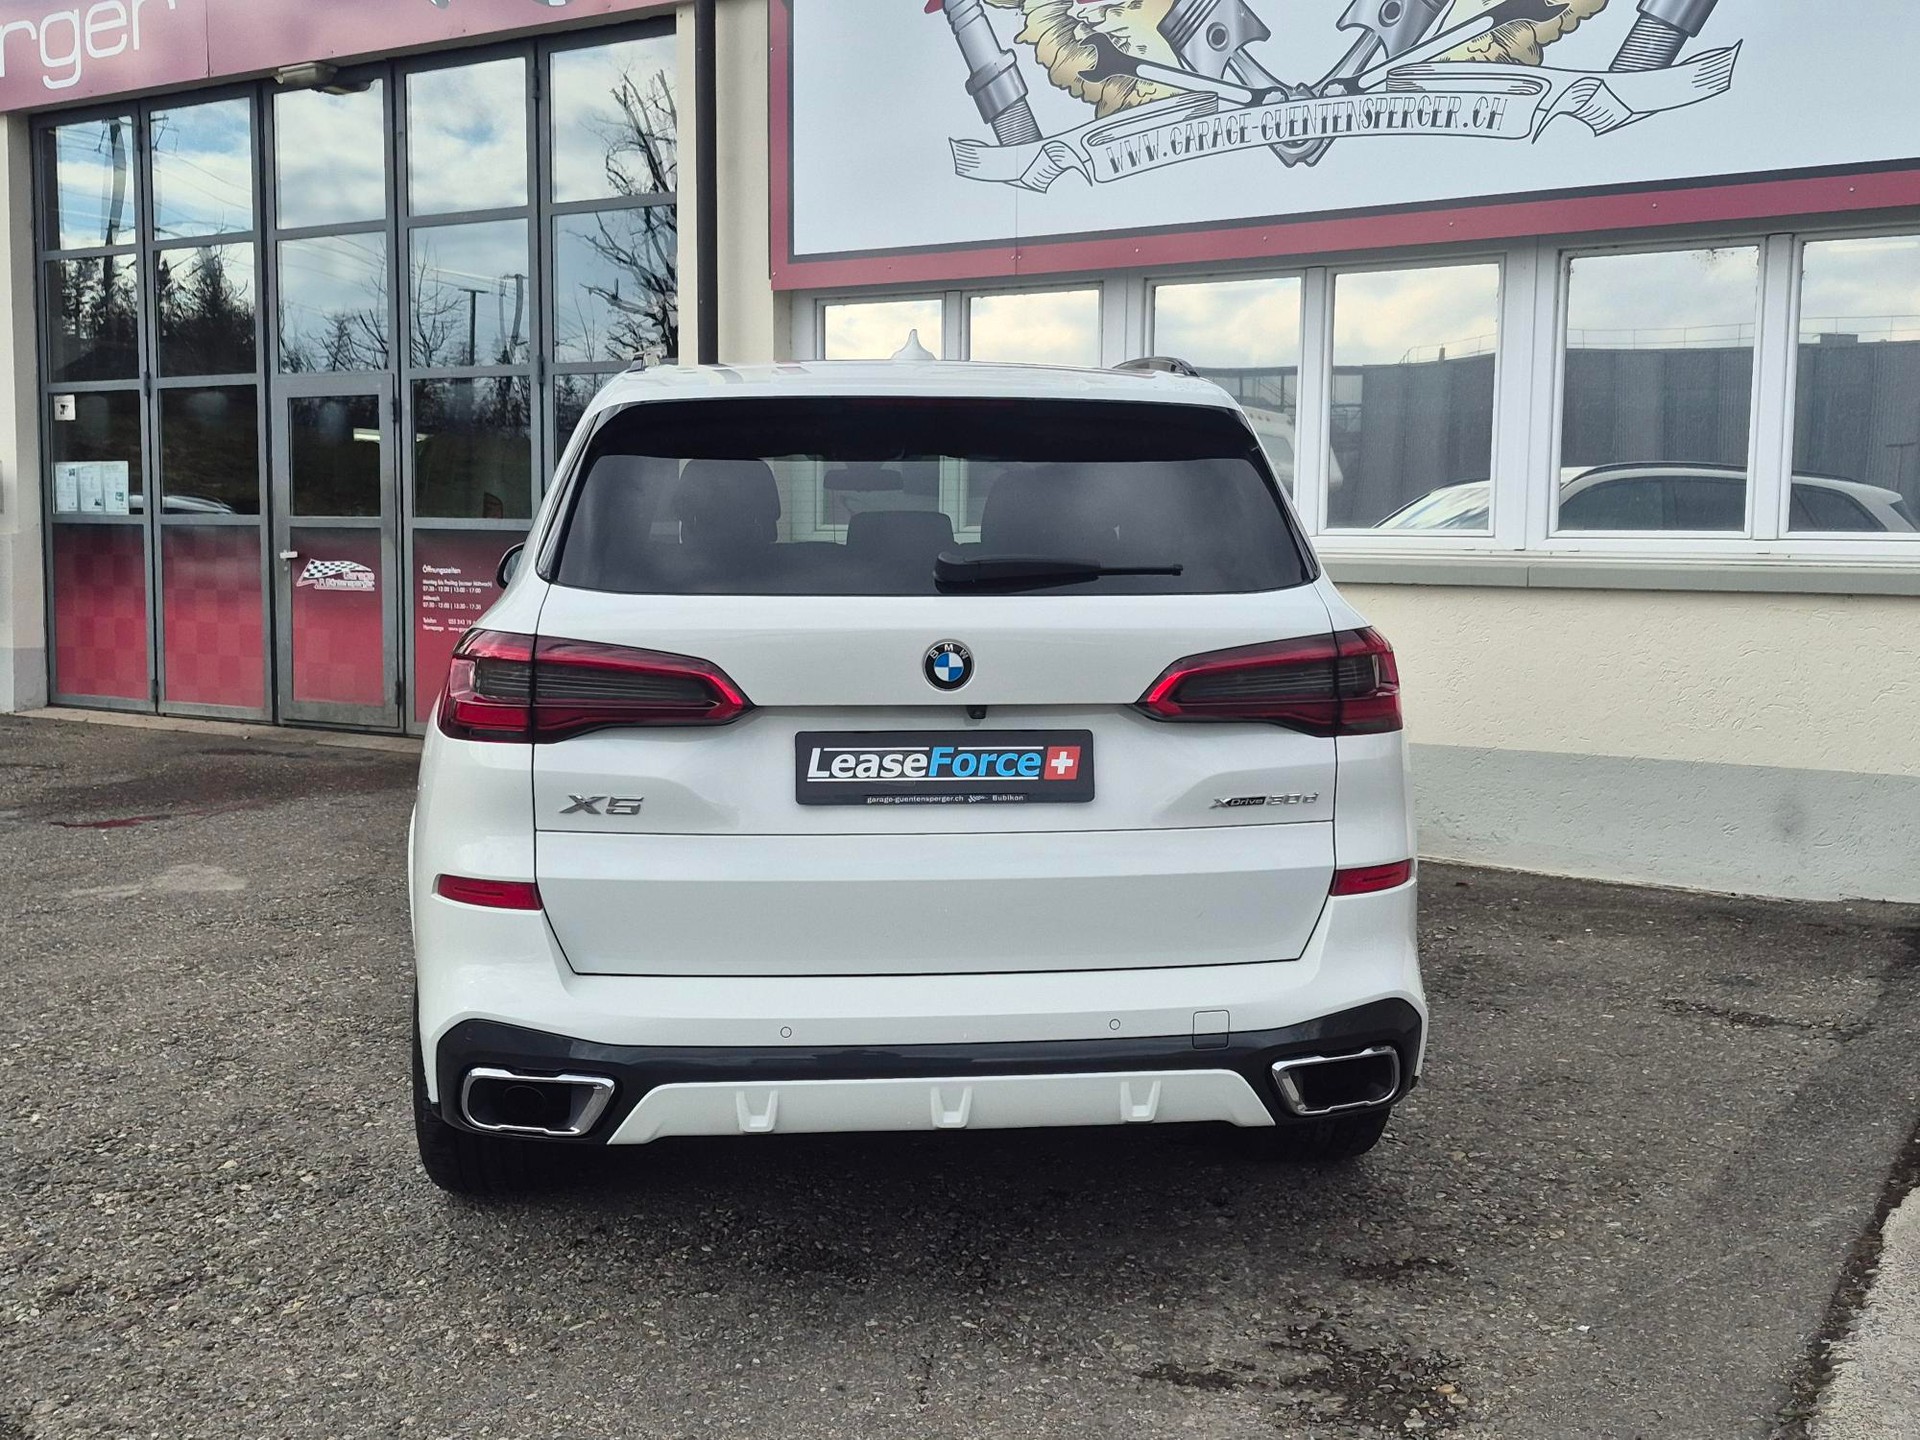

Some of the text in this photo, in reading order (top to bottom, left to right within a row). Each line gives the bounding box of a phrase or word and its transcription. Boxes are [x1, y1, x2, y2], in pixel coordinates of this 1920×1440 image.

[1105, 96, 1509, 174] WWW.GARAGE-GUENTENSPERGER.CH
[930, 644, 969, 660] BMW
[807, 747, 1042, 779] LeaseForce
[559, 794, 645, 815] X5
[992, 794, 1024, 802] Bubikon
